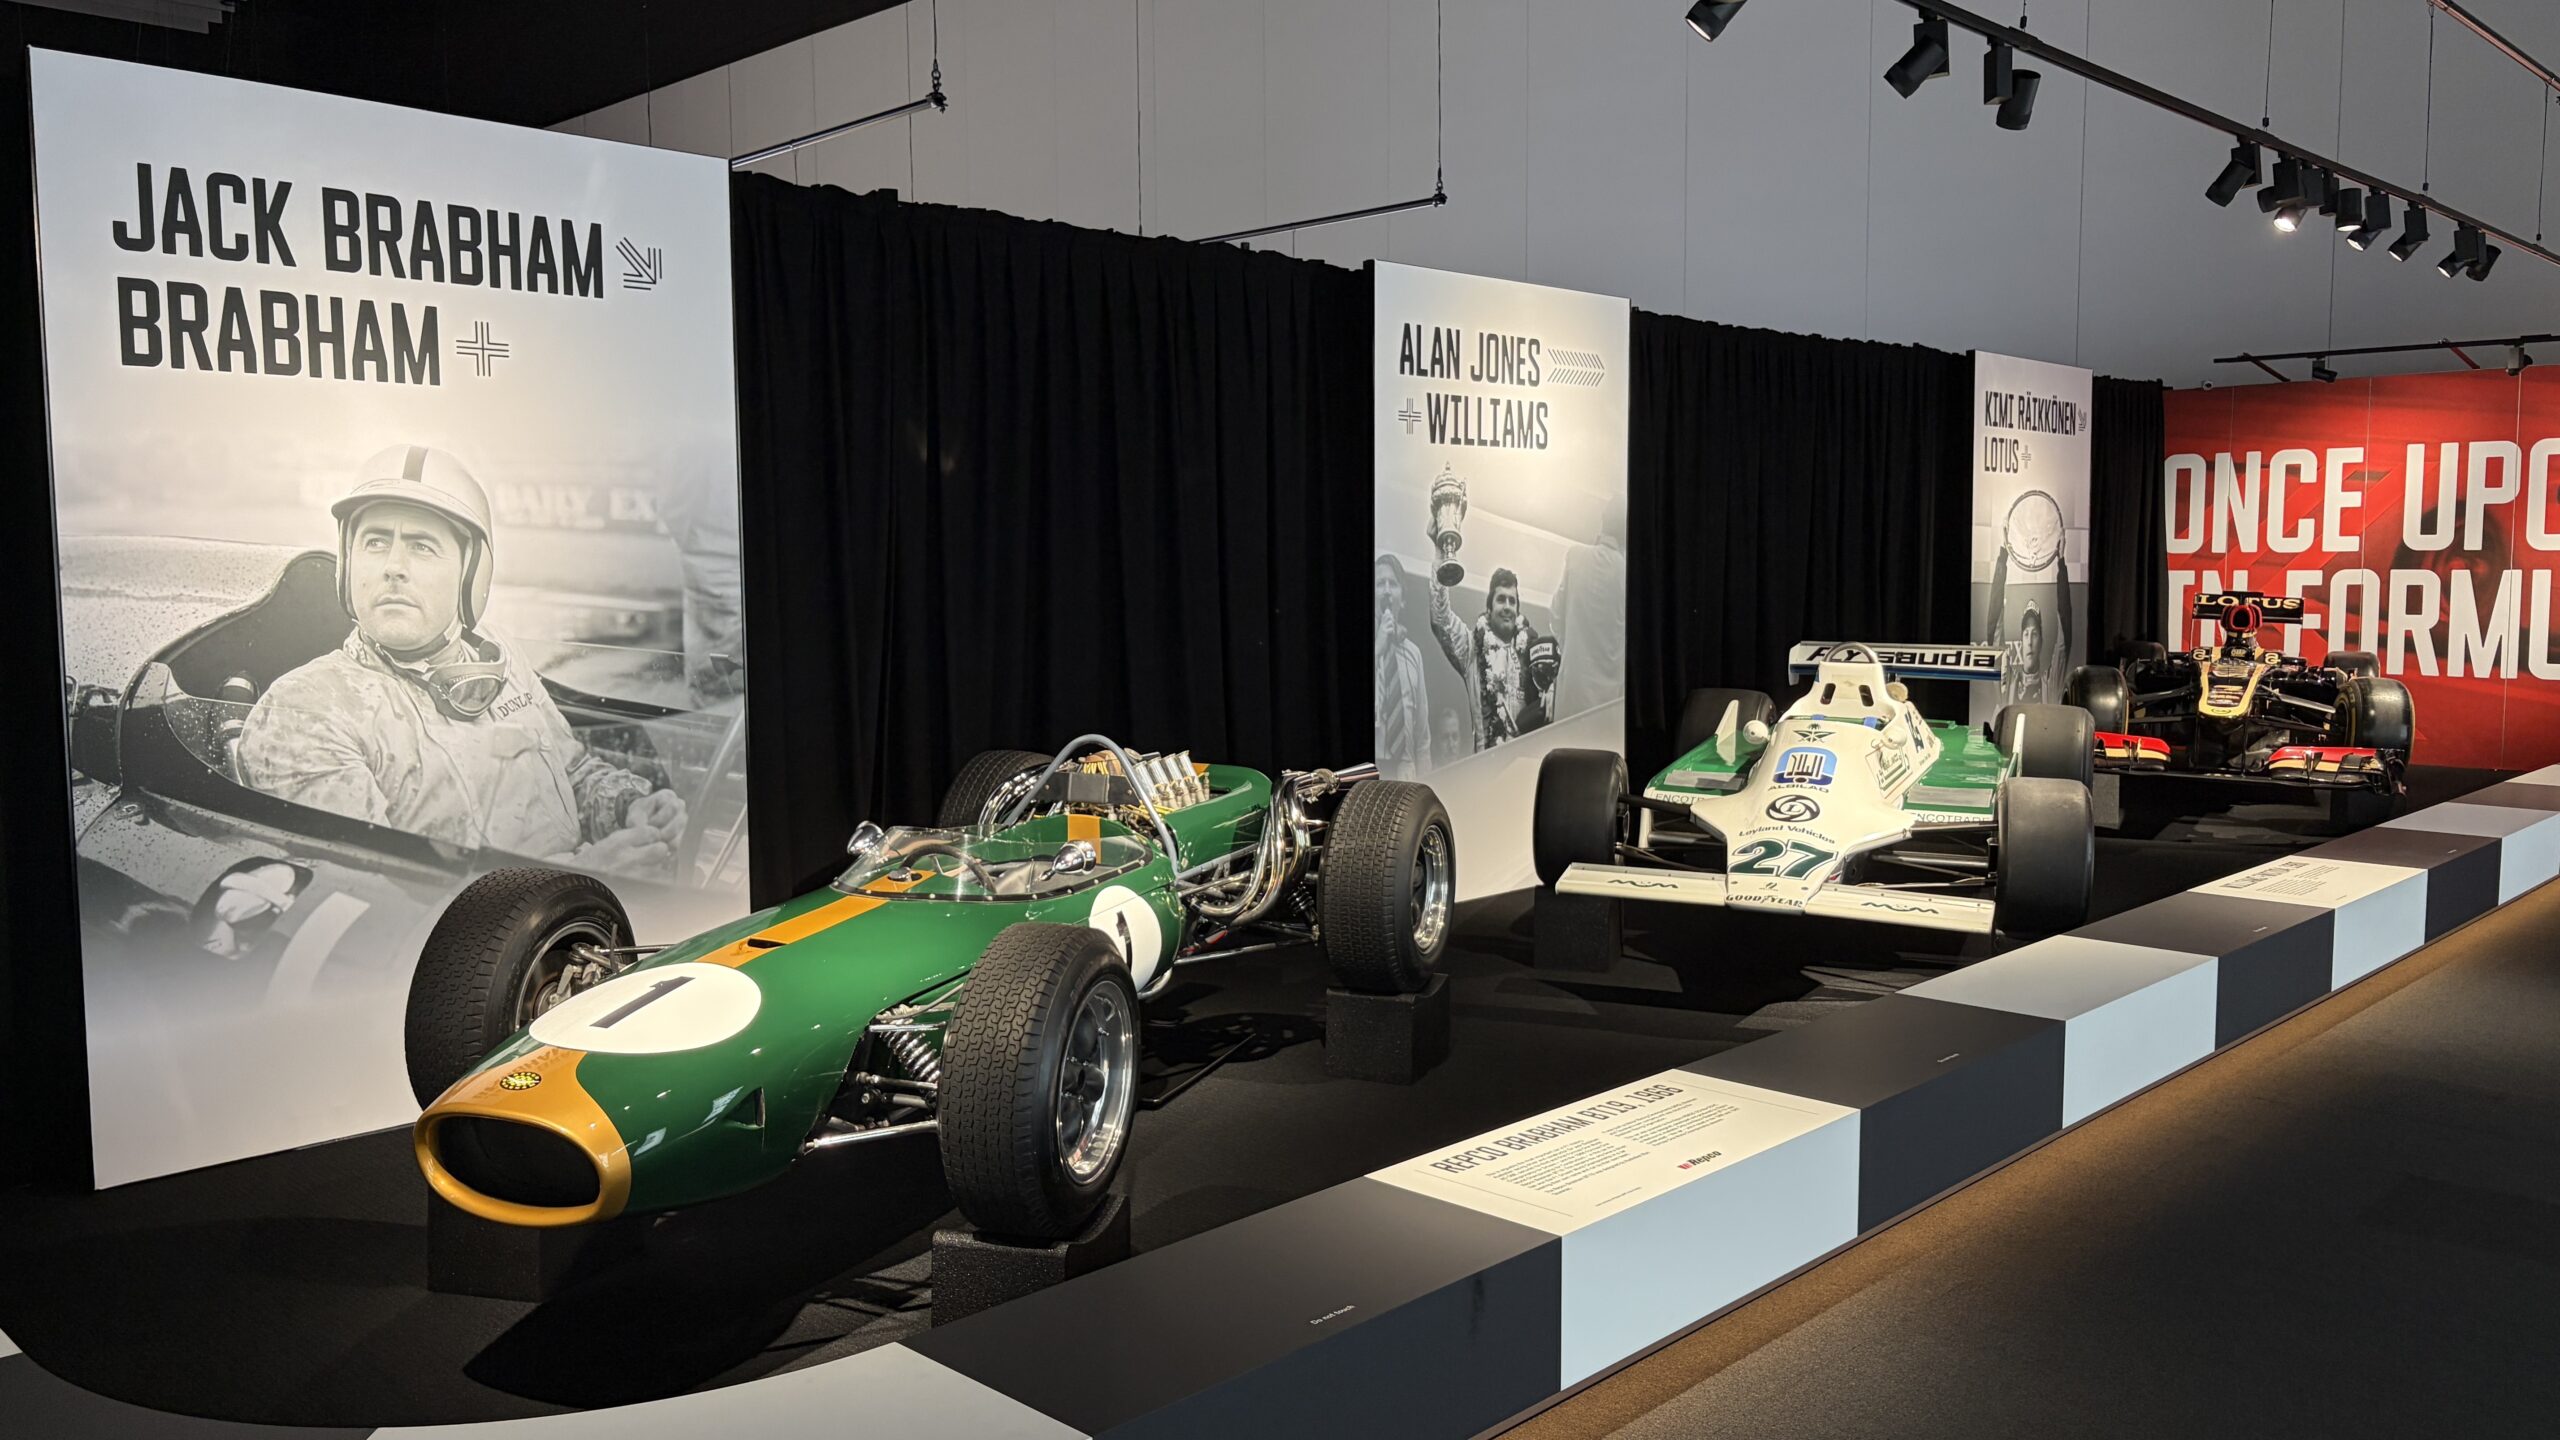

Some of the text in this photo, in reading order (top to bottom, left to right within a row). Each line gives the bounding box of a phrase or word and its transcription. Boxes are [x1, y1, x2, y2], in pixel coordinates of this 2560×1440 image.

[112, 162, 604, 299] JACK BRABHAM
[117, 276, 441, 386] BRABHAM
[1400, 323, 1541, 387] ALAN JONES
[1426, 392, 1549, 450] WILLIAMS
[1985, 391, 2077, 436] KIMI RÄIKKÖNEN
[1984, 436, 2019, 474] LOTUS
[2164, 446, 2365, 554] ONCE
[497, 692, 533, 718] DUNLP
[1728, 838, 1839, 880] 27
[1739, 825, 1836, 844] Leyland Vehicles
[588, 975, 697, 1029] 1
[1430, 1146, 1509, 1174] REPCO
[1493, 1115, 1595, 1151] BRABHAM
[1577, 1100, 1646, 1121] BT19,
[1625, 1084, 1684, 1104] 1966
[1687, 1150, 1722, 1166] Repco
